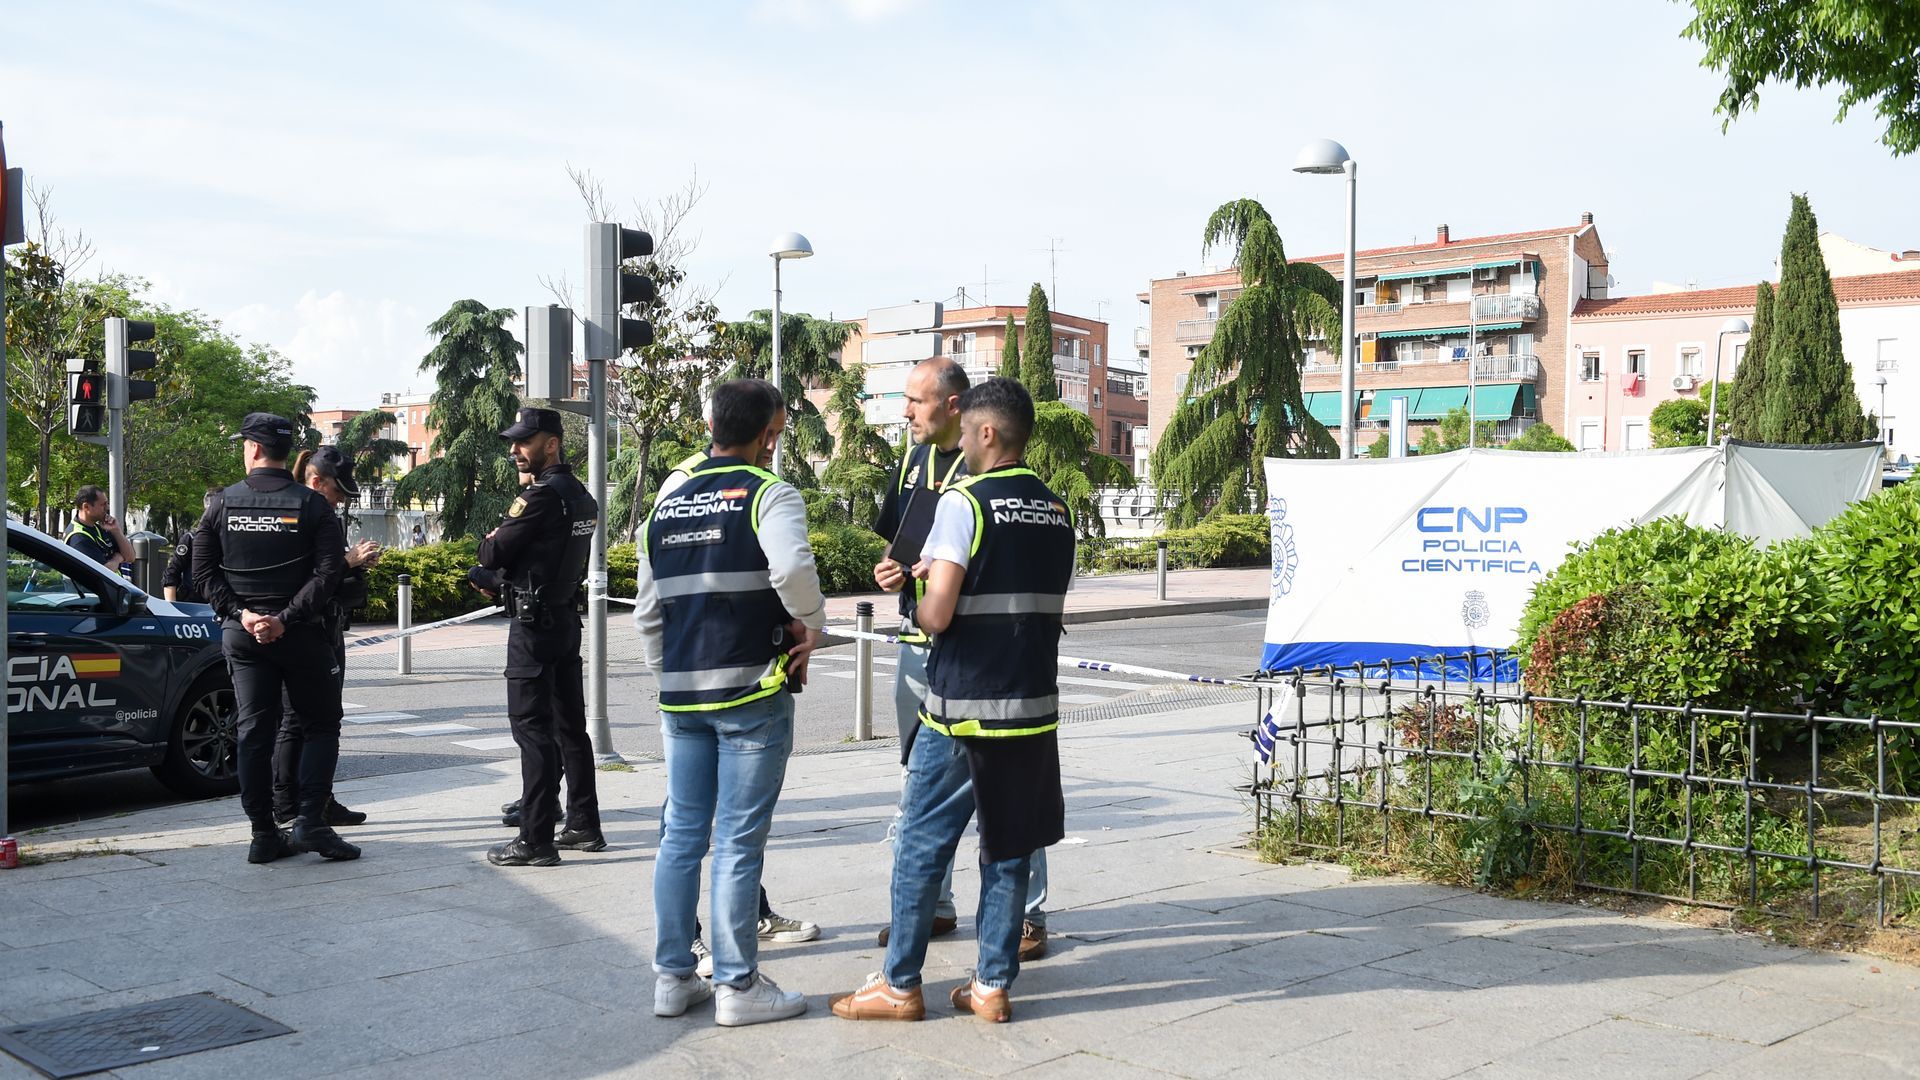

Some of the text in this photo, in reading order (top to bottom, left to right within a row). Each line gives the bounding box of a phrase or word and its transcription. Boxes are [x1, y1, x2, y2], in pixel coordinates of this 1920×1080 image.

[659, 490, 723, 510] POLICIA
[989, 497, 1057, 512] POLICIA
[654, 500, 743, 521] NACIONAL
[993, 510, 1069, 528] NACIONAL
[227, 516, 284, 524] POLICIA
[1416, 507, 1528, 533] CNP
[661, 528, 722, 546] HOMICIDIOS
[1423, 539, 1522, 553] POLICIA
[1401, 558, 1542, 574] CIENTIFICA
[183, 623, 211, 639] 091
[7, 682, 118, 713] ONAL
[115, 709, 158, 722] @policia
